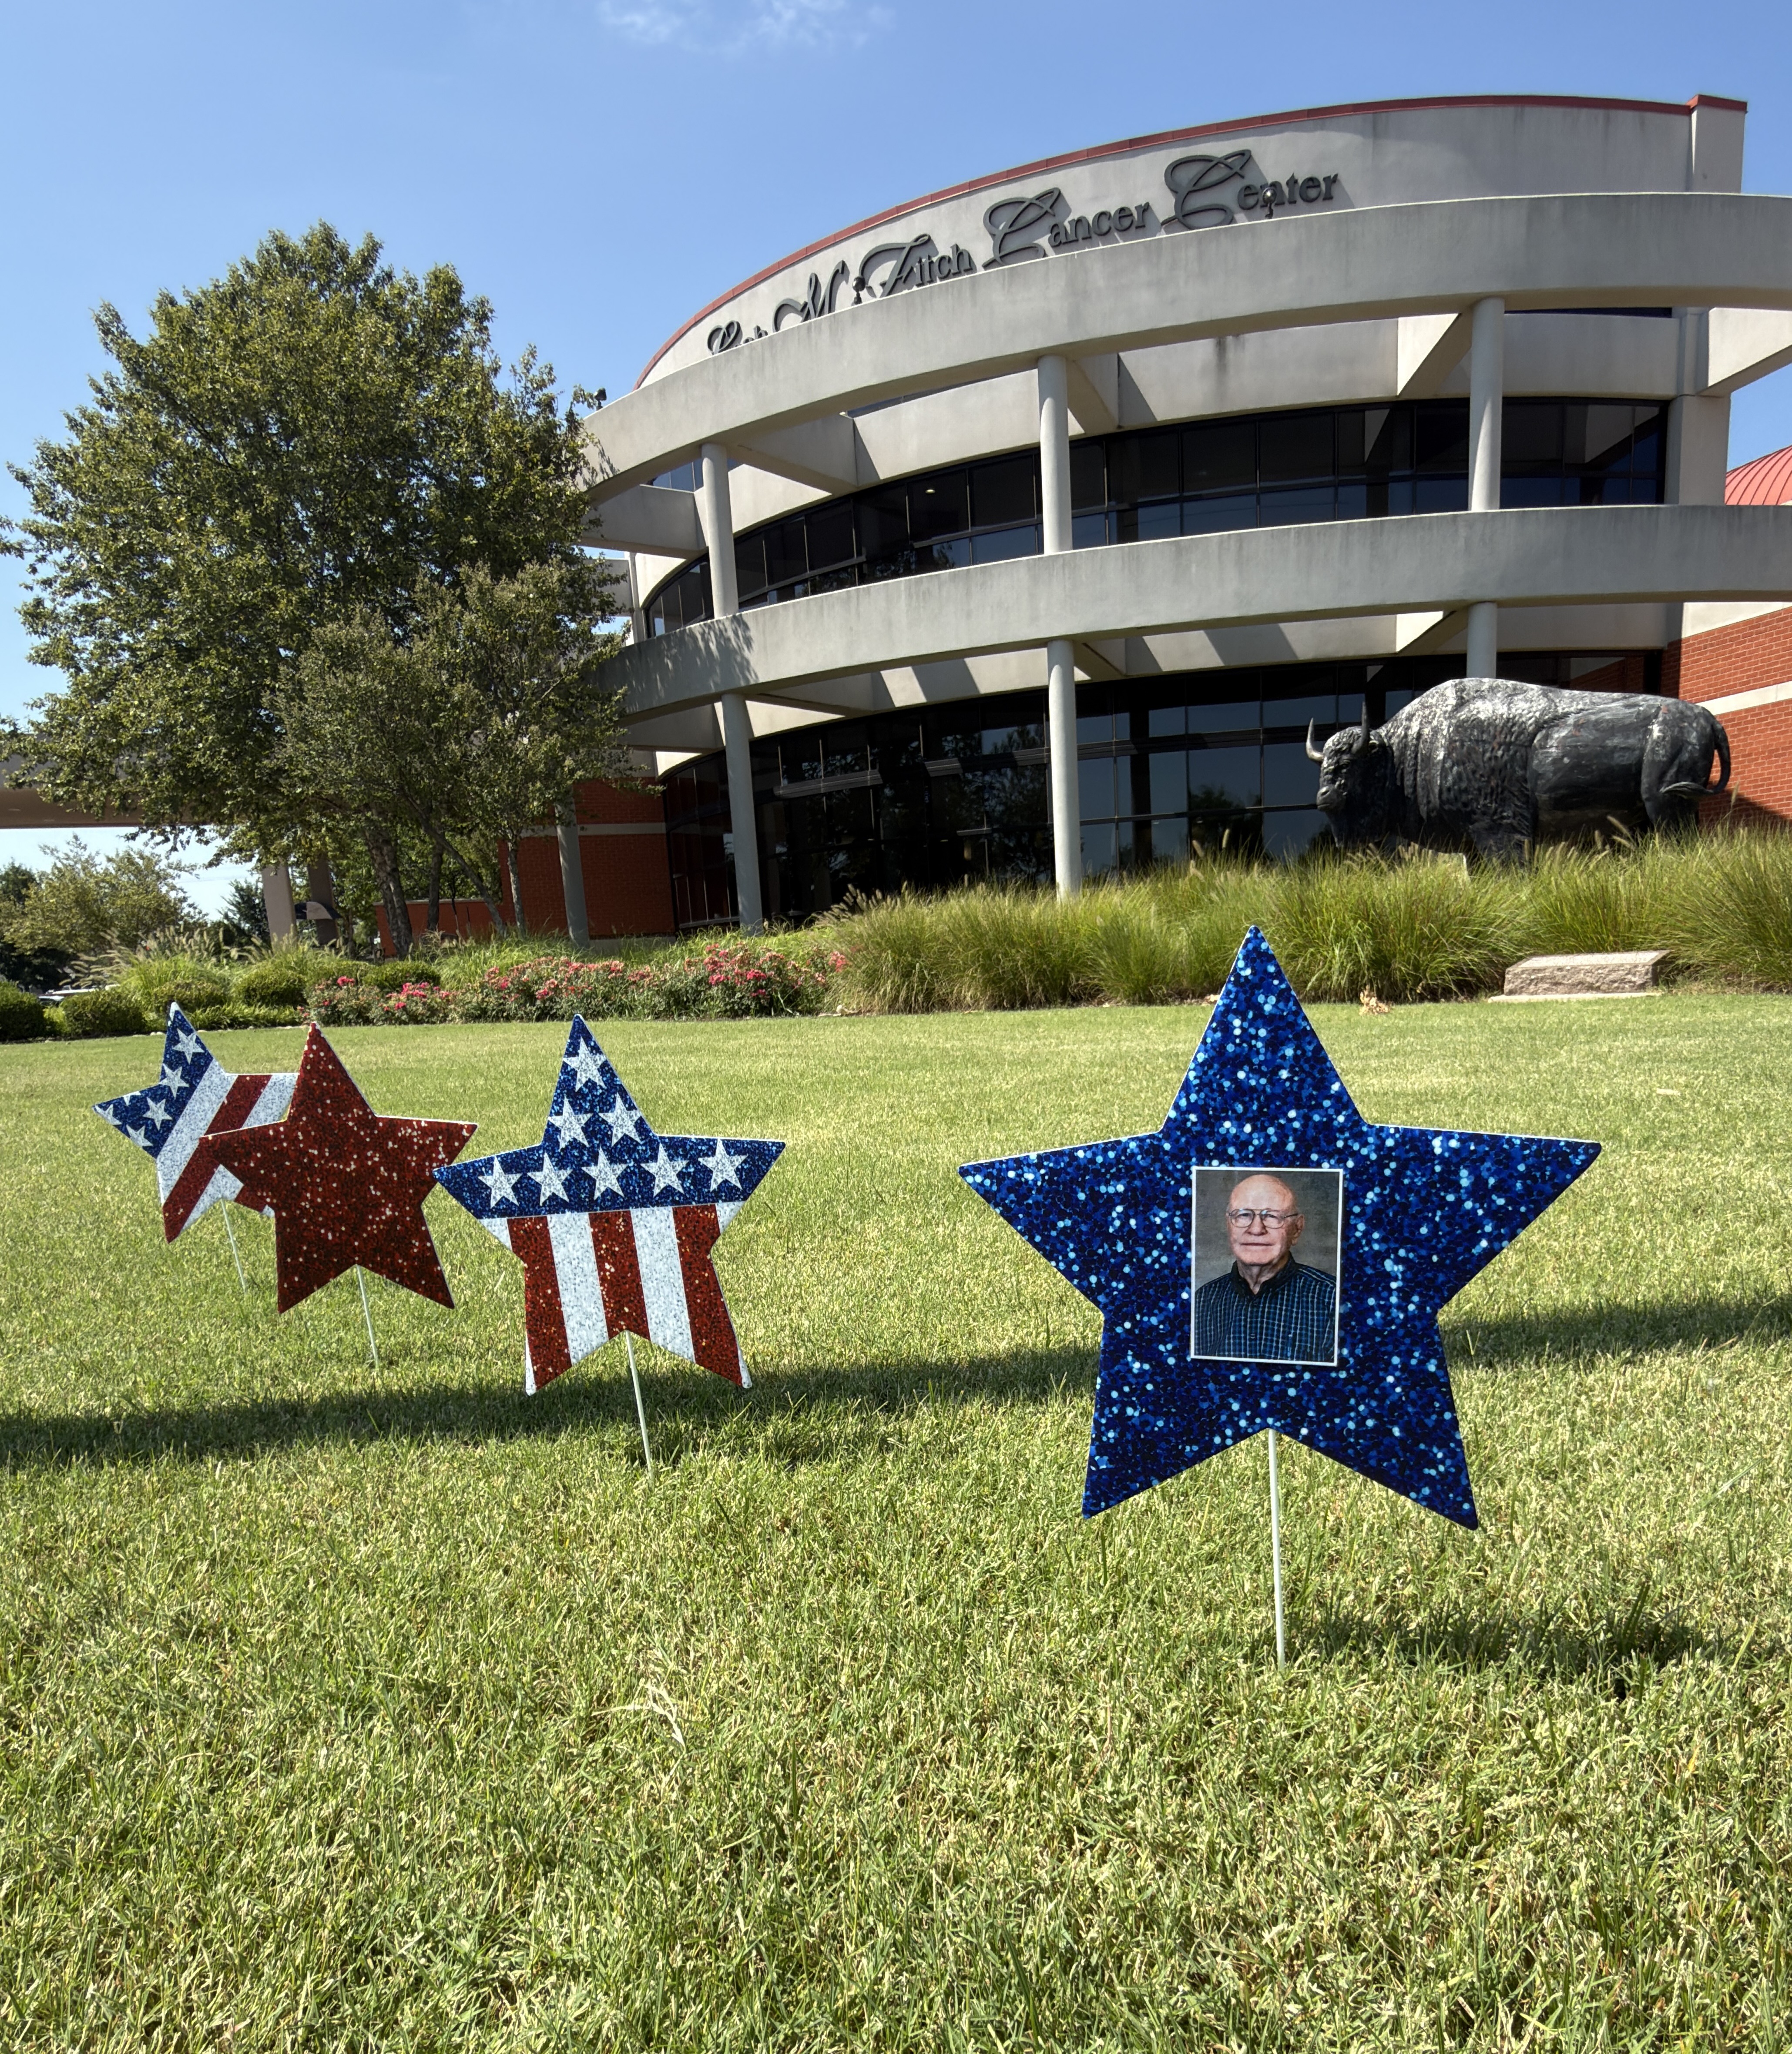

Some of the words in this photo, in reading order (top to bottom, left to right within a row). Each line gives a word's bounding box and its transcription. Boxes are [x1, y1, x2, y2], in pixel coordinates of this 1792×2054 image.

[859, 233, 973, 297] Fitch
[982, 187, 1150, 268] Cancer
[1161, 149, 1339, 230] Center
